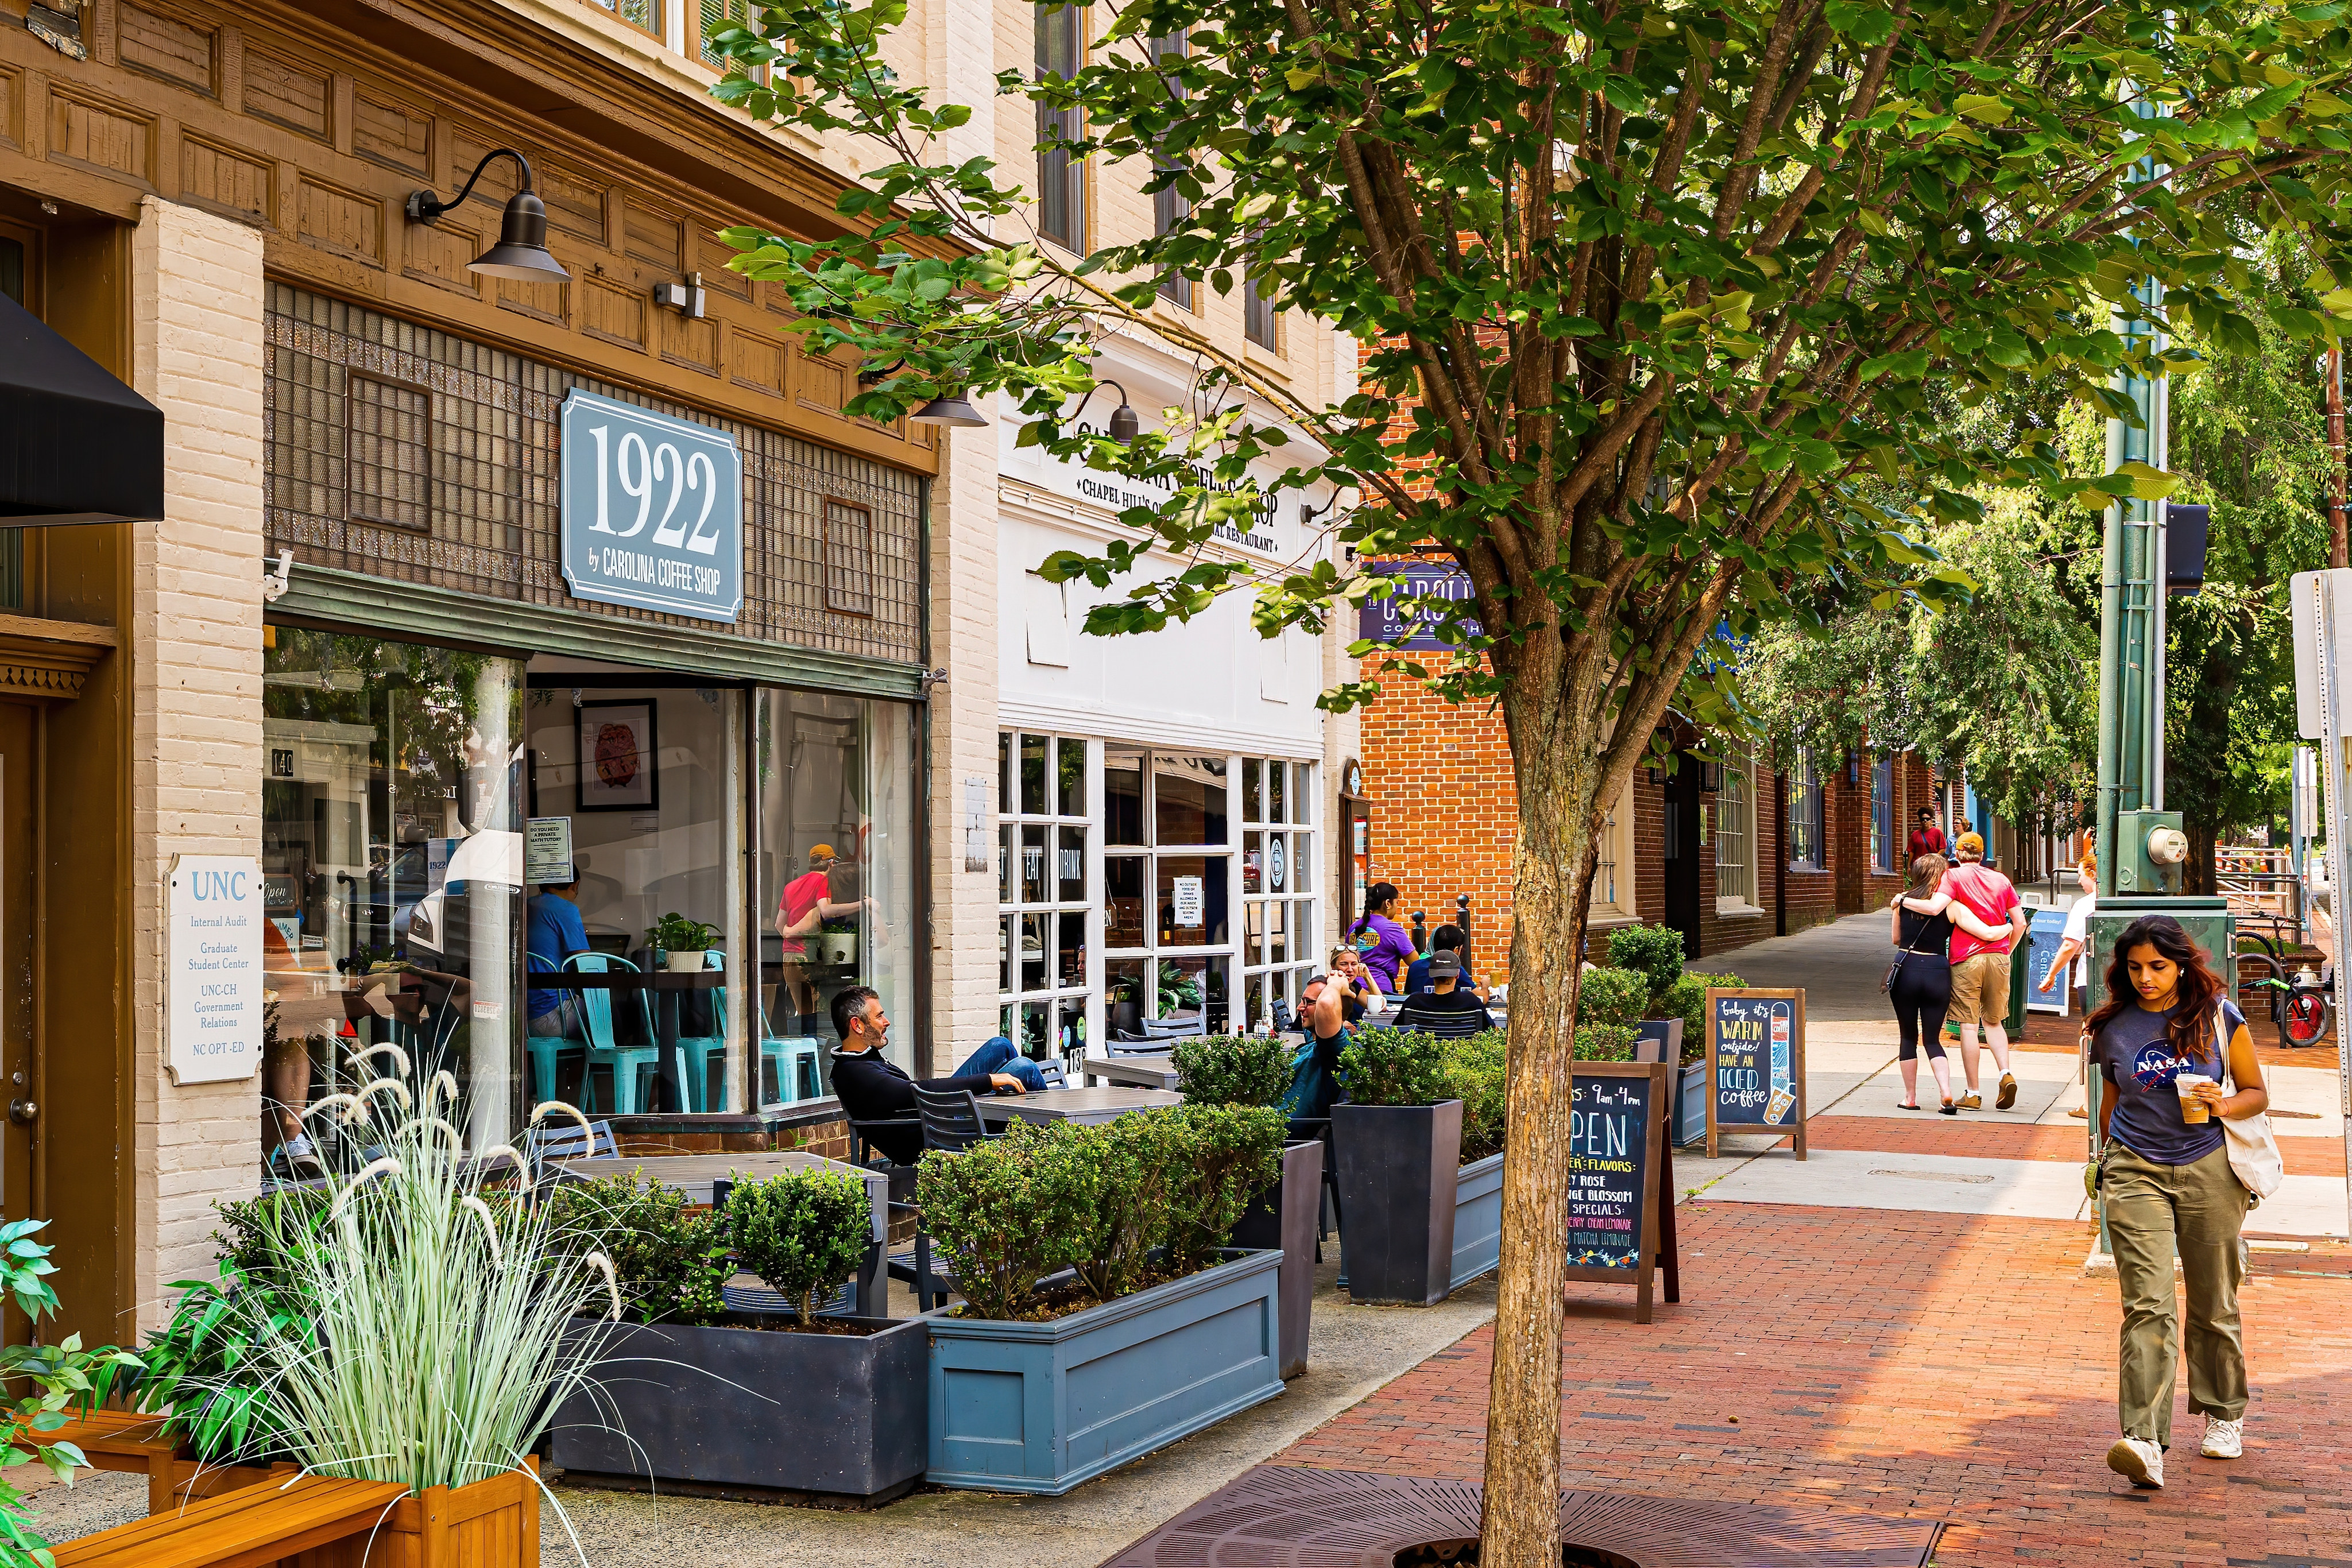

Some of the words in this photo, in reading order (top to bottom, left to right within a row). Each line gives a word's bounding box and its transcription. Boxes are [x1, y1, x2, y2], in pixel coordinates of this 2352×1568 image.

[588, 424, 719, 556] 1922
[1082, 478, 1120, 504] CHAPEL
[1226, 525, 1274, 553] RESTAURANT
[589, 547, 599, 572] by
[603, 547, 656, 584] CAROLINA
[657, 556, 693, 592] COFFEE
[694, 565, 720, 597] SHOP
[429, 861, 446, 870] 1922
[1026, 849, 1040, 880] EAT
[1059, 849, 1081, 880] DRINK
[1297, 855, 1303, 869] 22
[192, 871, 246, 901] UNC
[191, 916, 223, 927] Internal
[225, 915, 247, 927] Audit
[200, 942, 238, 954] Graduate
[188, 958, 220, 970] Student
[222, 957, 249, 969] Center
[201, 983, 237, 997] UNC-CH
[194, 1001, 243, 1013] Government
[1721, 1000, 1748, 1022] baby
[1753, 1002, 1769, 1018] it's
[200, 1016, 238, 1029] Relations
[1719, 1020, 1763, 1041] WARM
[193, 1044, 206, 1056] NC
[208, 1043, 227, 1055] OPT
[229, 1042, 245, 1054] -ED
[1721, 1040, 1760, 1055] outside!
[1719, 1054, 1738, 1067] HAVE
[1742, 1055, 1754, 1067] AN
[2136, 1057, 2192, 1073] NASA
[1719, 1068, 1759, 1090] ICED
[1721, 1090, 1768, 1108] coffee
[1570, 1109, 1626, 1156] PEN
[1588, 1159, 1637, 1172] FLAVORS:
[1580, 1175, 1606, 1187] ROSE
[1588, 1189, 1633, 1203] BLOSSOM
[1572, 1203, 1625, 1215] SPECIALS:
[1587, 1218, 1604, 1229] CREAM
[1605, 1218, 1632, 1230] LEMONADE
[1574, 1232, 1599, 1245] MATCHA
[1601, 1232, 1631, 1247] LEMONADE
